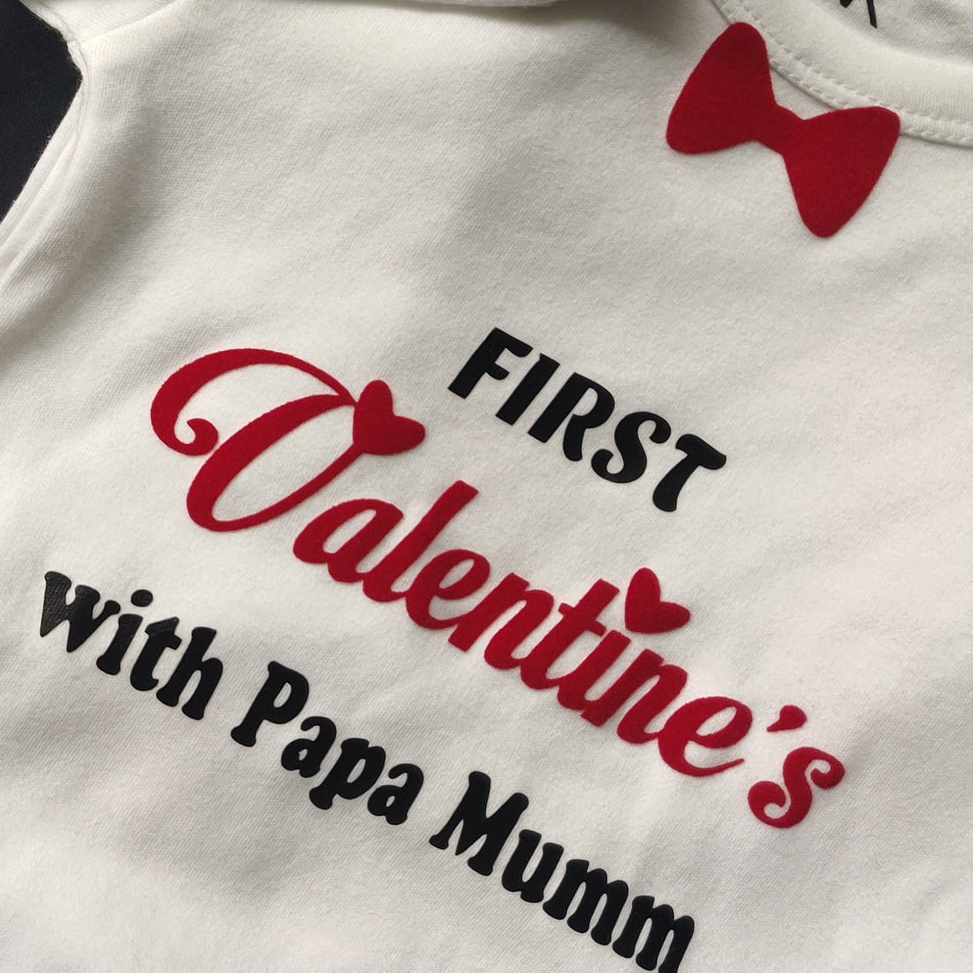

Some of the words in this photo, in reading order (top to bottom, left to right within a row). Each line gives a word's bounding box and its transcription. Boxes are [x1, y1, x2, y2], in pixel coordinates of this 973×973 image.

[150, 347, 846, 829] Valentine's
[447, 327, 727, 512] FIRST
[40, 571, 224, 720] with
[230, 662, 425, 825] Papa
[429, 771, 696, 973] Mumm
